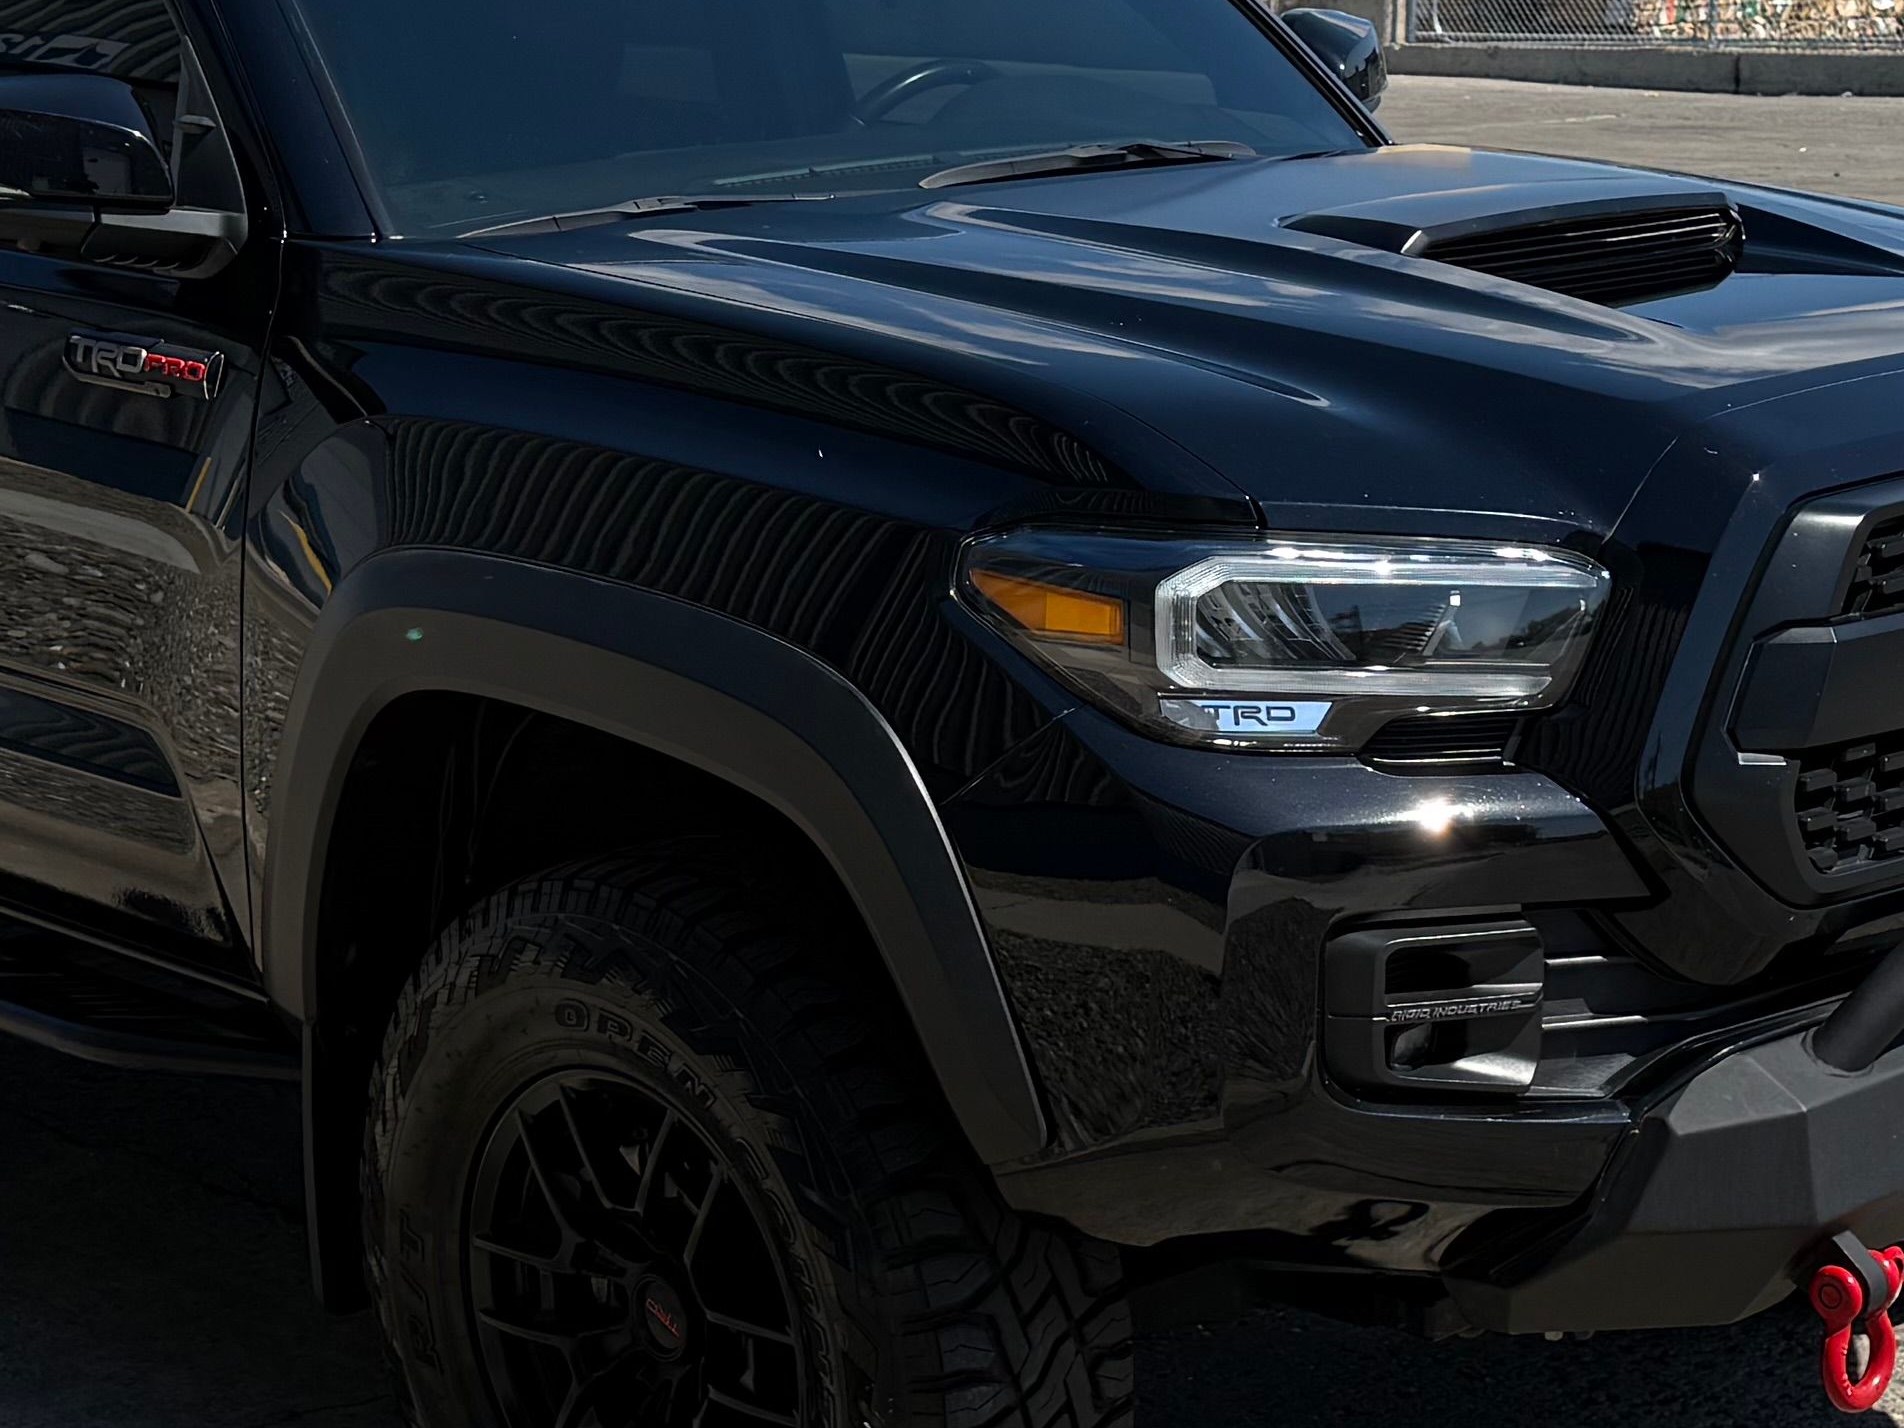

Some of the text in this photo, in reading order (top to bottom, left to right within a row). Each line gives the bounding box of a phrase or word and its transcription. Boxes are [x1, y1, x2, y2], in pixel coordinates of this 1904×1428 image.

[69, 334, 207, 382] TRD PRO
[1200, 704, 1297, 727] TRD
[1432, 999, 1522, 1018] INDUSTRIES
[554, 997, 718, 1110] OPEN
